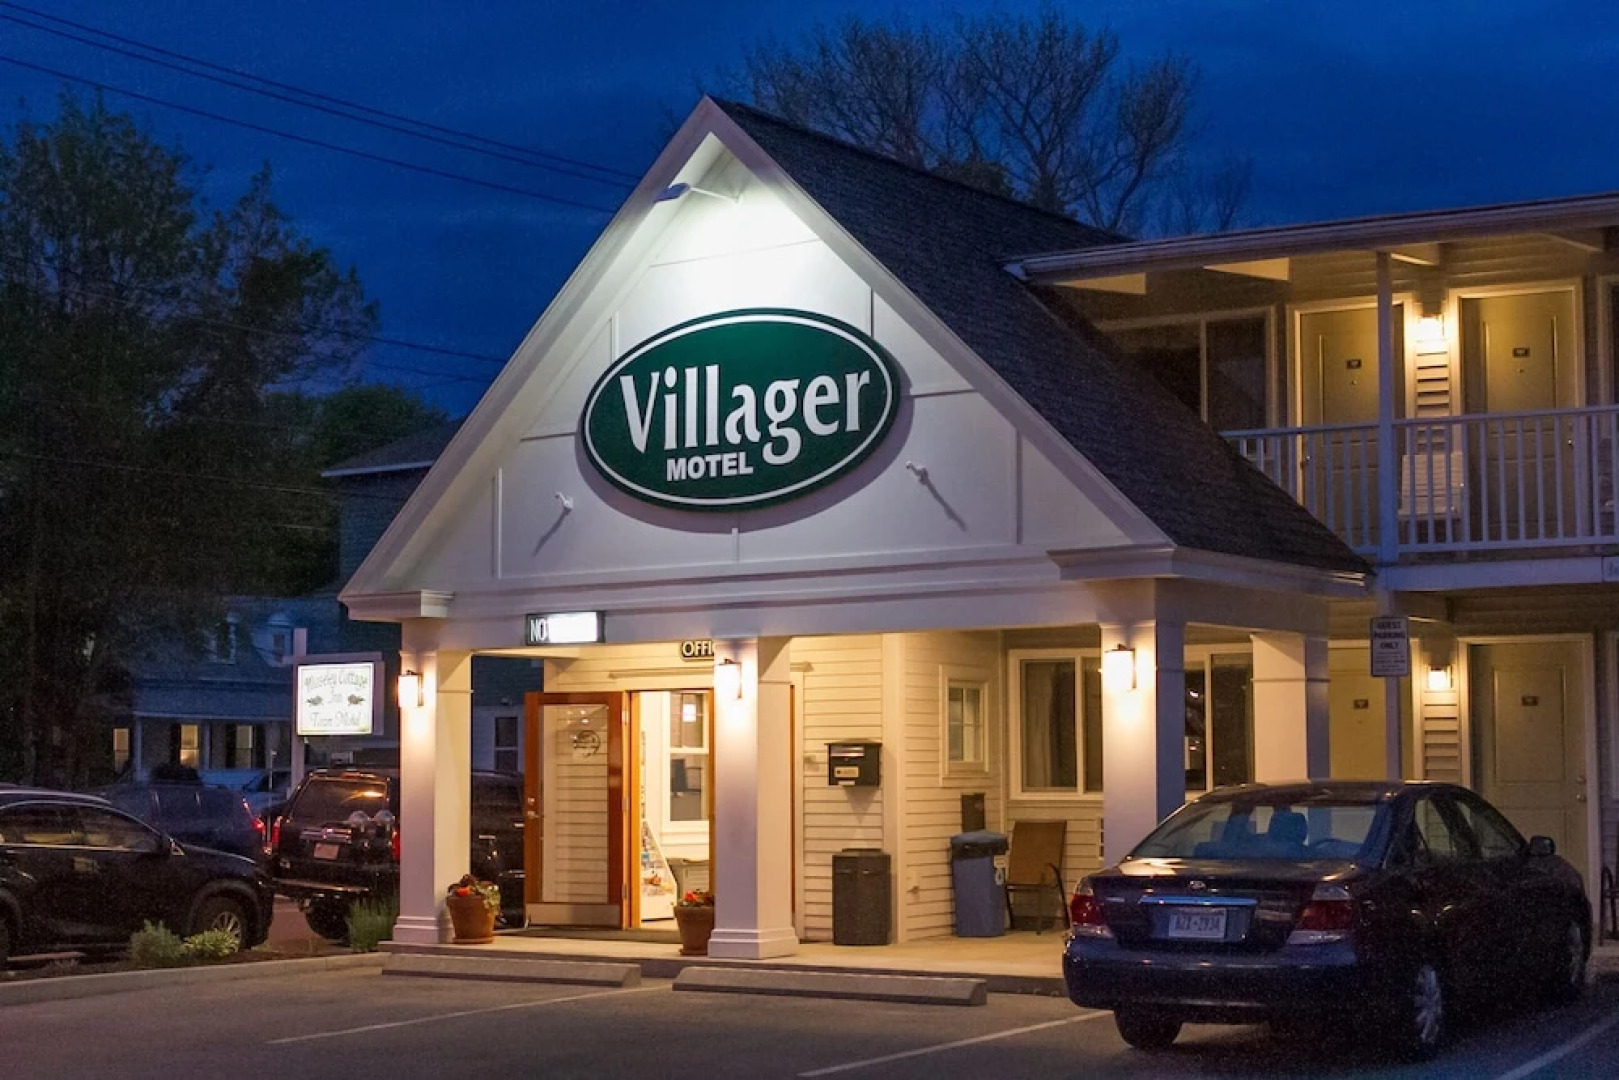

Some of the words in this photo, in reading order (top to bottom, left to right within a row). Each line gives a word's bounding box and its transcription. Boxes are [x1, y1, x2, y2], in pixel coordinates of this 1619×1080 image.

[619, 364, 871, 466] Villager
[666, 452, 754, 481] MOTEL
[530, 618, 547, 642] NO
[682, 640, 714, 657] OFFI
